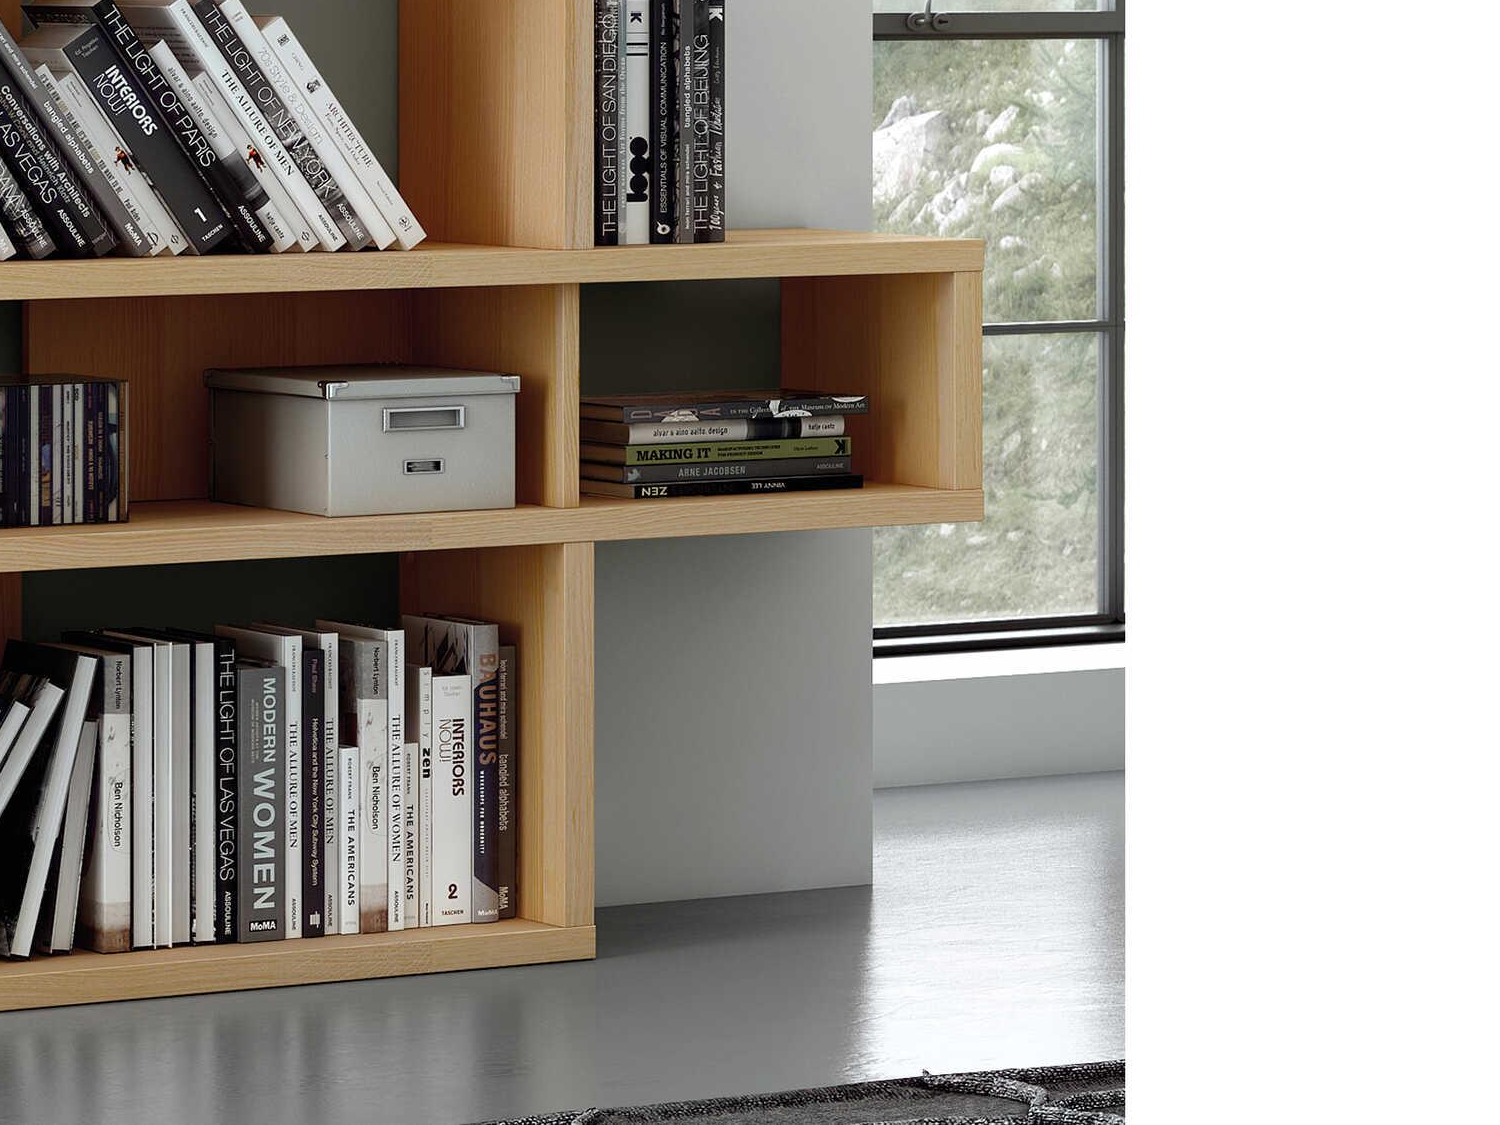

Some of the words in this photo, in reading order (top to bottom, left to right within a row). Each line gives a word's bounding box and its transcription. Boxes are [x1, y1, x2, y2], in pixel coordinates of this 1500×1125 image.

[602, 14, 616, 71] DIEGO
[104, 4, 134, 45] THE
[125, 39, 168, 91] LIGHT
[160, 91, 184, 115] OF
[176, 115, 216, 167] PARIS
[105, 64, 158, 136] INTERIORS
[204, 4, 234, 43] THE
[225, 38, 265, 86] LIGHT
[258, 86, 281, 109] OF
[301, 144, 338, 198] YORK
[602, 75, 616, 112] SAN
[602, 116, 616, 141] OF
[15, 144, 58, 205] VEGAS
[602, 144, 616, 197] LIGHT
[602, 200, 616, 236] THE
[636, 448, 693, 461] MAKING
[697, 447, 711, 458] IT
[678, 467, 700, 477] ARNE
[703, 466, 746, 475] JACOBSEN
[219, 649, 235, 687] THE
[219, 691, 235, 745] LIGHT
[263, 677, 276, 763] MODERN
[392, 715, 400, 740] THE
[478, 653, 498, 765] BAUHAUS
[219, 747, 235, 773] OF
[372, 766, 380, 783] Ben
[392, 744, 400, 791] ALLURE
[422, 748, 431, 778] zen
[453, 718, 465, 796] INTERIORS
[114, 782, 123, 800] Ben
[219, 777, 235, 813] LAS
[372, 786, 380, 830] Nicholson
[392, 795, 400, 809] OF
[114, 802, 123, 847] Nicholson
[253, 768, 276, 910] WOMEN
[392, 814, 400, 862] WOMEN
[219, 815, 235, 881] VEGAS
[448, 884, 458, 899] 2
[250, 921, 276, 932] MoMA
